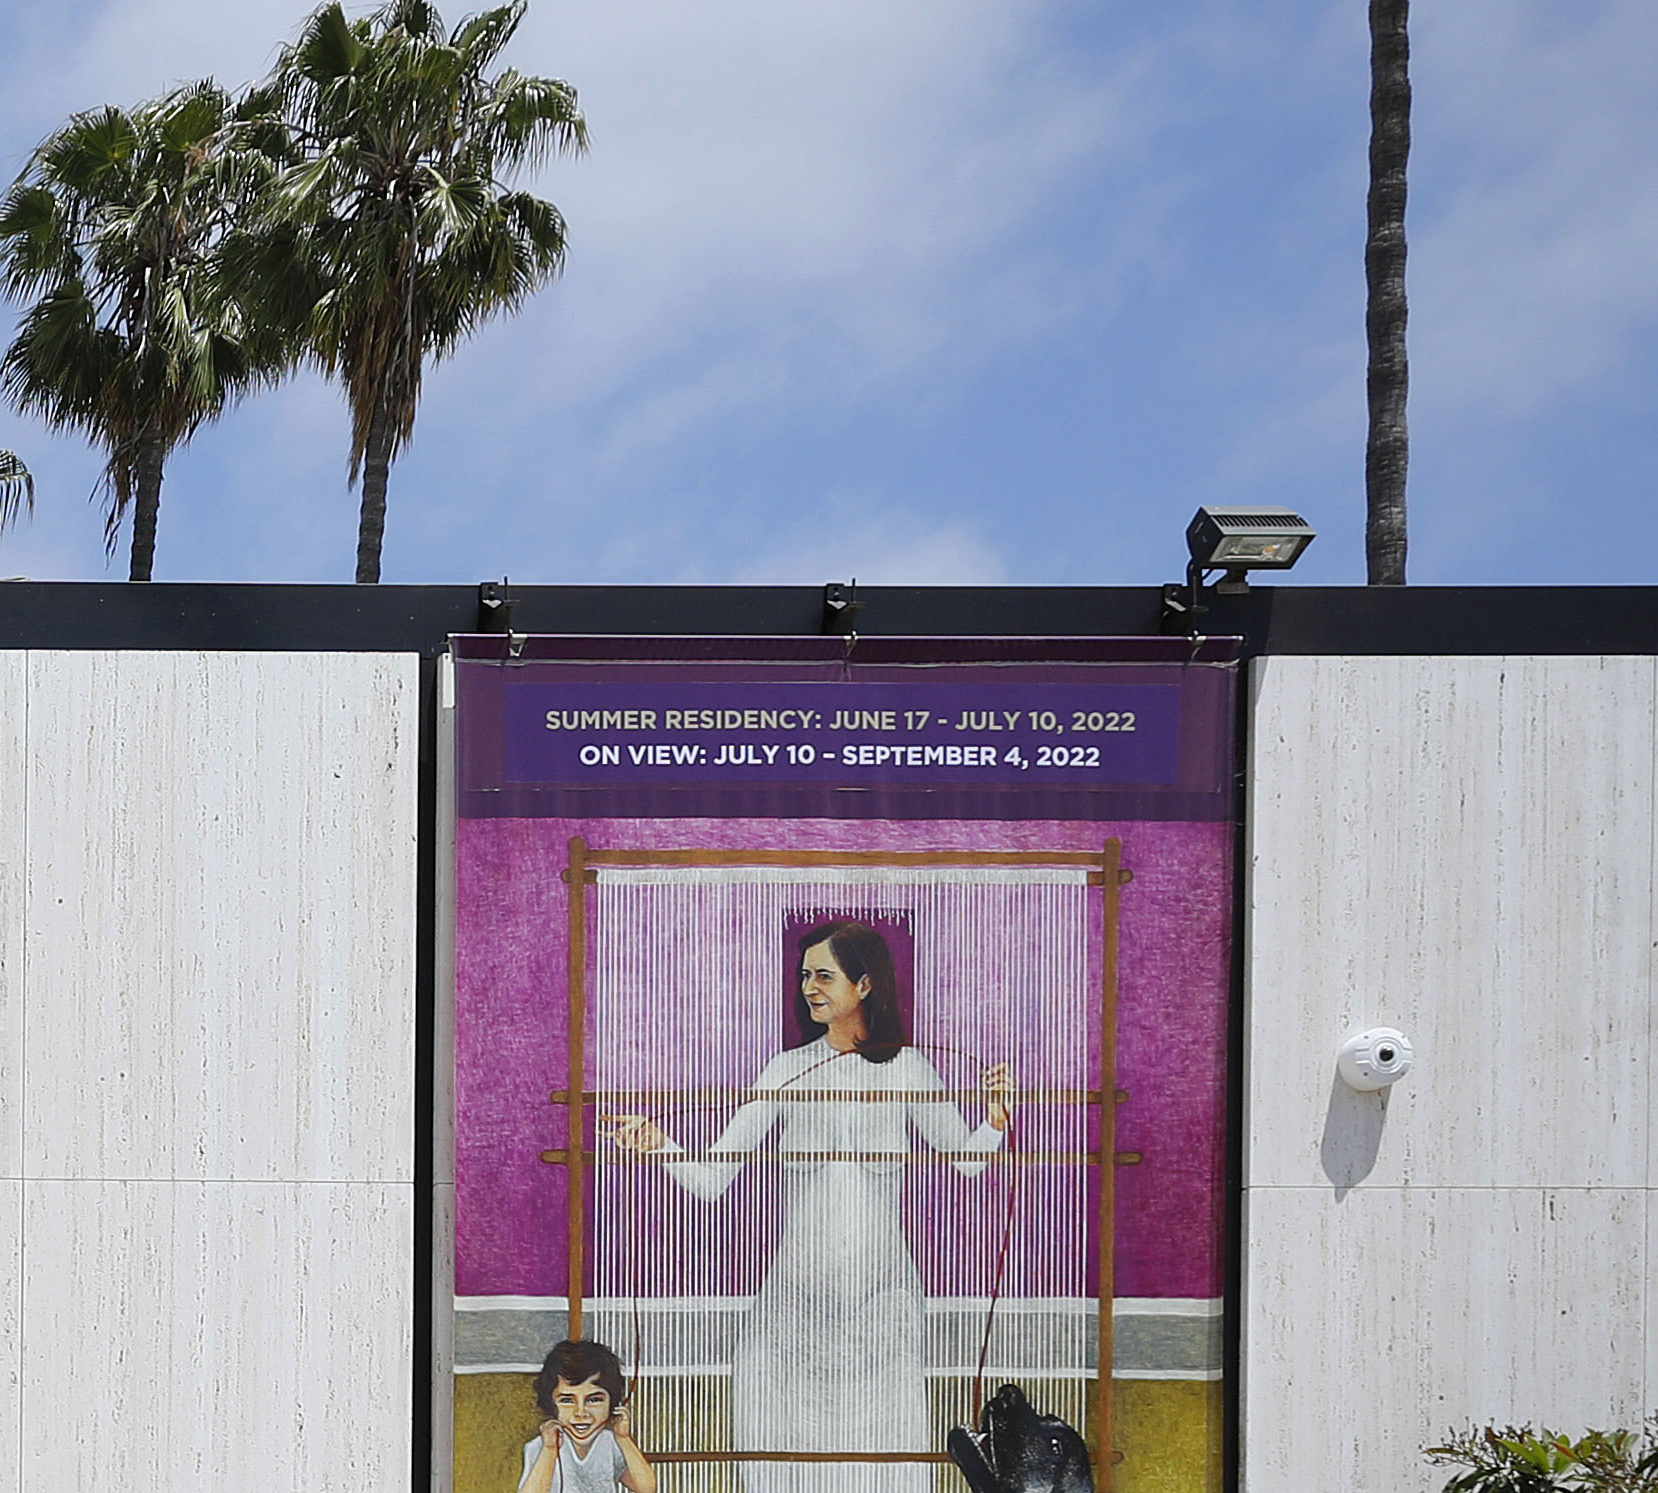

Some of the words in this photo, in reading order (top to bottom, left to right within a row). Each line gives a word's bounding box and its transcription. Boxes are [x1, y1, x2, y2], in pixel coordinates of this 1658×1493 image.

[545, 710, 656, 731] SUMMER
[665, 710, 822, 731] RESIDENCY:
[828, 710, 896, 731] JUNE
[903, 710, 930, 731] 17
[954, 710, 1020, 731] JULY
[1028, 710, 1064, 733] 10,
[1072, 710, 1135, 732] 2022
[579, 745, 621, 766] ON
[628, 745, 707, 766] VIEW:
[713, 745, 779, 766] JULY
[786, 745, 815, 766] 10
[842, 745, 997, 766] SEPTEMBER
[1003, 745, 1030, 769] 4,
[1036, 745, 1100, 767] 2022
